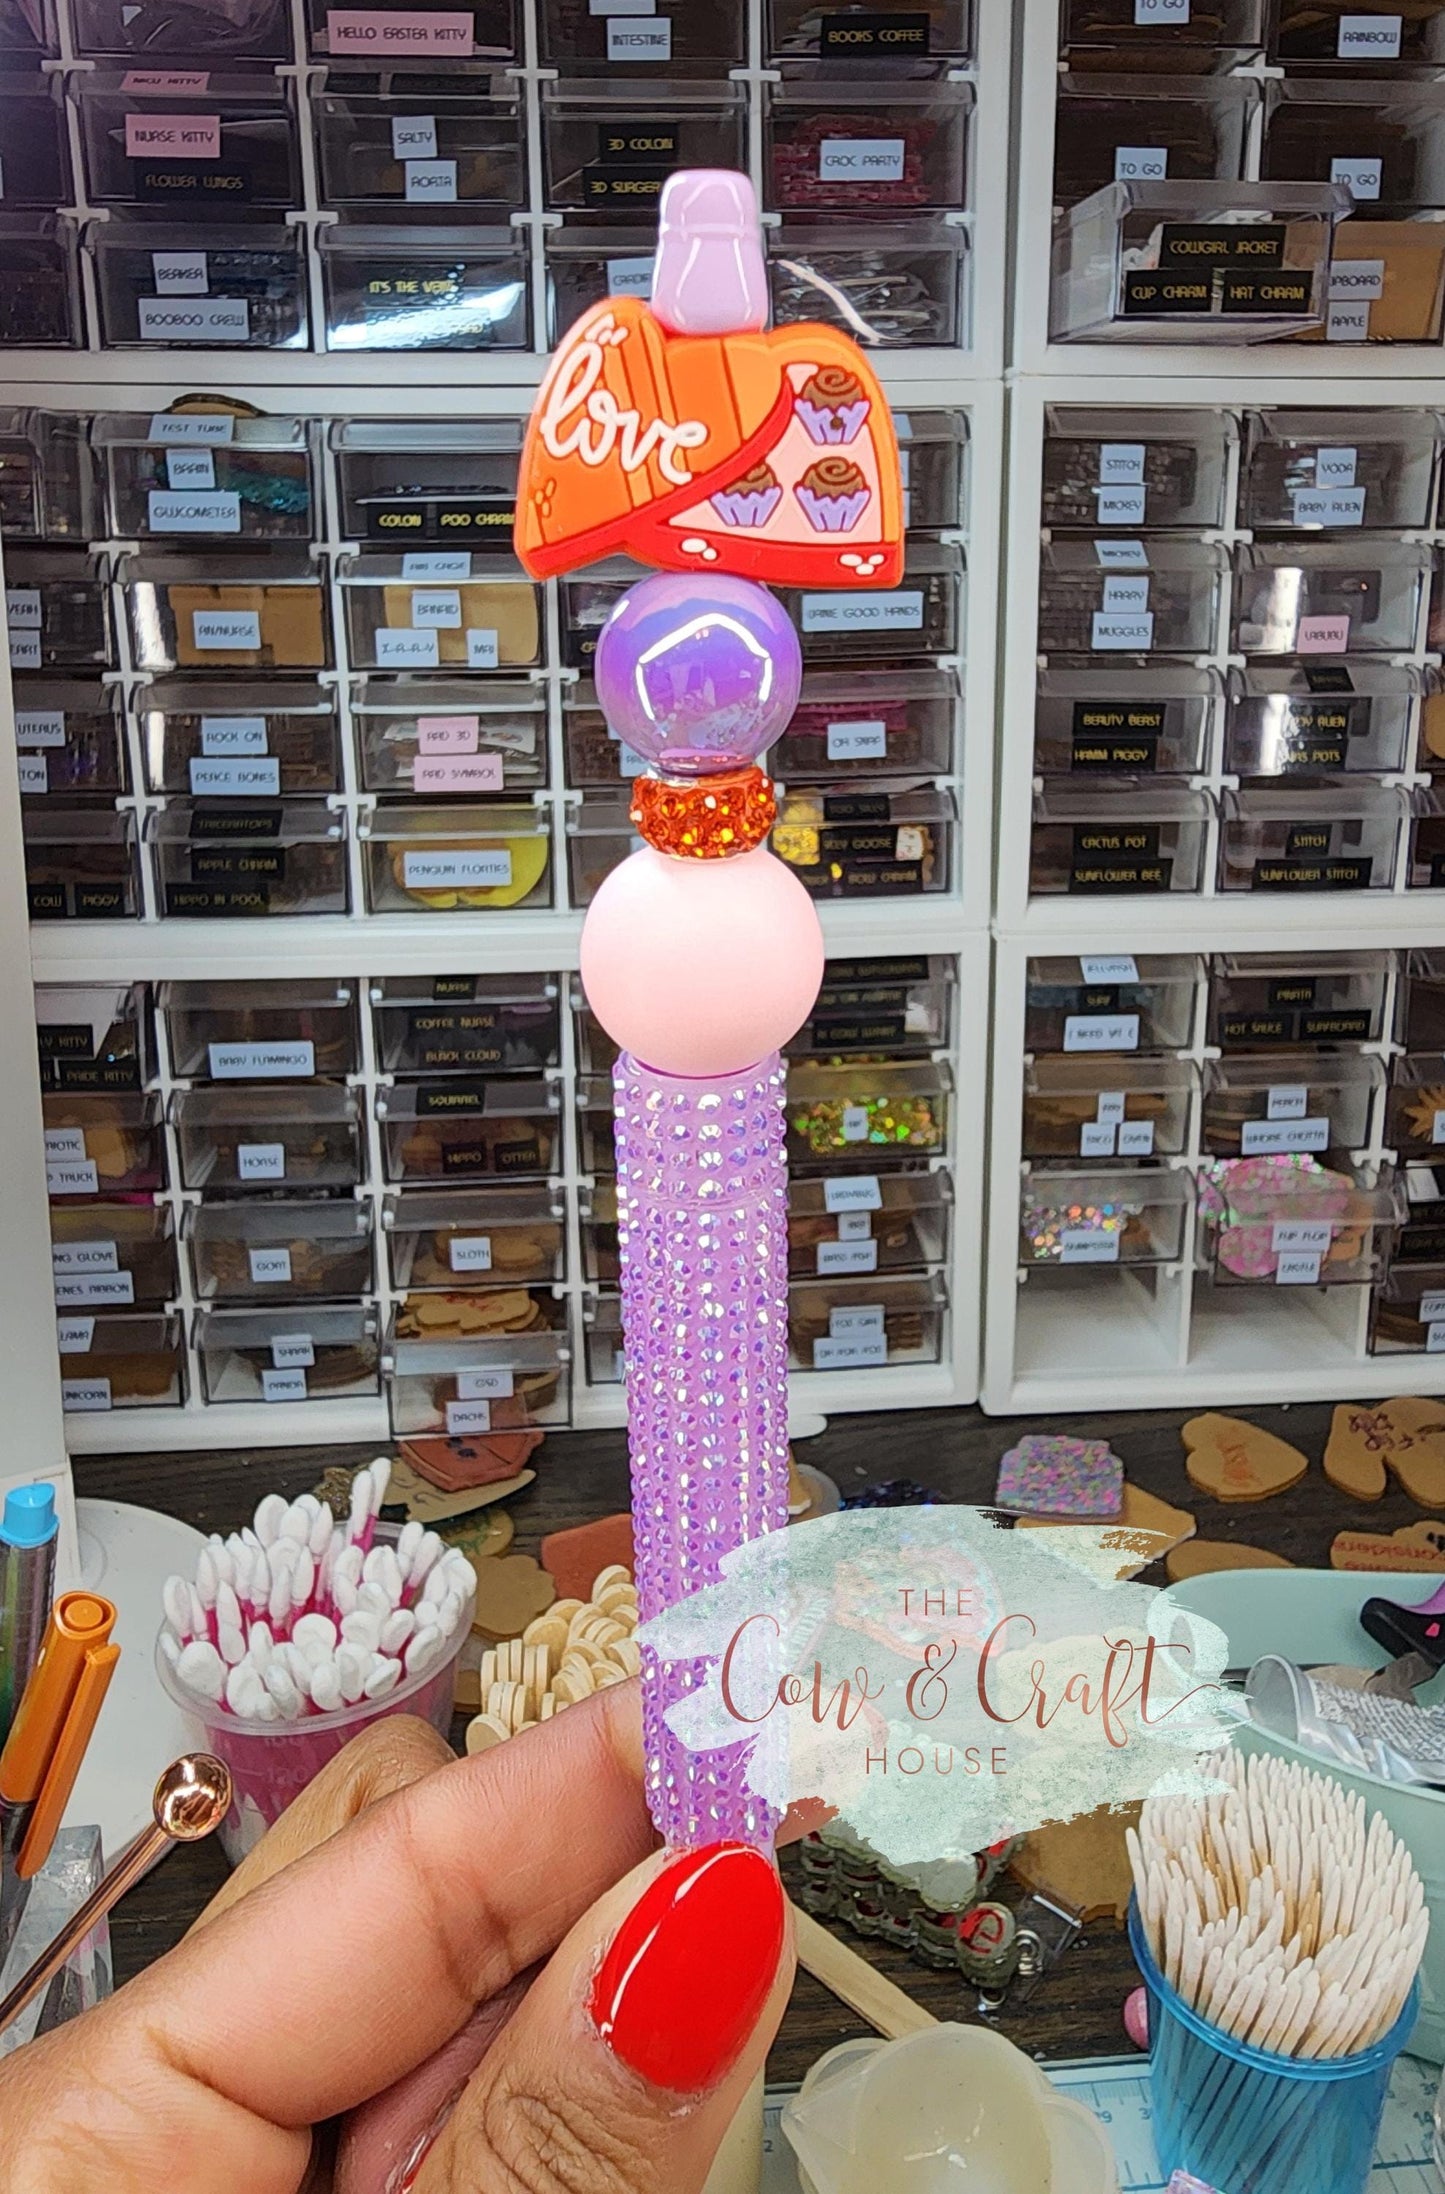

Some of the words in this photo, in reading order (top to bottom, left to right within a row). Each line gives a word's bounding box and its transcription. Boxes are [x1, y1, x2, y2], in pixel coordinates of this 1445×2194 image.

[337, 27, 377, 40] HELLO
[383, 27, 428, 40] EASTER
[434, 28, 468, 40] KITTY
[828, 30, 873, 43] BOOKS
[879, 29, 925, 42] COFFEE
[1343, 31, 1398, 44] RAINBOW
[135, 130, 176, 144] NURSE
[181, 130, 215, 144] KITTY
[397, 132, 433, 145] SALTY
[608, 138, 625, 151] 3D
[629, 138, 674, 151] COLON
[825, 155, 857, 167] CROC
[862, 154, 900, 167] PARTY
[1120, 163, 1137, 175] TO
[1143, 163, 1163, 175] GO
[145, 175, 198, 189] FLOWER
[203, 175, 244, 189] LUNGS
[1357, 173, 1377, 186] GO
[1170, 241, 1229, 255] COWGIRL
[1235, 240, 1279, 255] JACKET
[369, 280, 391, 294] IT'S
[394, 280, 419, 294] THE
[1131, 287, 1156, 300] CUP
[1163, 286, 1207, 299] CHARM
[1230, 287, 1253, 299] HAT
[1260, 287, 1304, 299] CHARM
[145, 313, 204, 327] BOOBOO
[209, 313, 245, 326] CREW
[1331, 315, 1365, 327] APPLE
[540, 342, 708, 486] love
[1106, 460, 1140, 471] STITCH
[1321, 463, 1353, 474] YODA
[1103, 501, 1142, 511] MICKEY
[1298, 502, 1326, 513] BABY
[1332, 501, 1362, 513] ALIEN
[378, 514, 422, 527] COLON
[440, 513, 471, 526] POO
[1108, 590, 1144, 601] HARRY
[843, 607, 879, 619] GOOD
[884, 606, 919, 617] HANDS
[1098, 626, 1149, 637] MUGGLES
[1083, 713, 1124, 727] BEAUTY
[1128, 713, 1162, 727] BEAST
[244, 731, 264, 742] ON
[833, 738, 850, 749] OH
[1113, 749, 1149, 761] PIGGY
[1081, 836, 1121, 849] CACTUS
[1124, 836, 1147, 849] POT
[1293, 834, 1326, 848] STITCH
[1074, 869, 1137, 882] SUNFLOWER
[1141, 869, 1163, 882] BEE
[1259, 868, 1321, 882] SUNFLOWER
[1326, 867, 1359, 880] STITCH
[33, 896, 62, 908] COW
[1225, 1024, 1246, 1035] HOT
[1251, 1023, 1283, 1034] SAUCE
[1306, 1019, 1365, 1033] SURFBOARD
[77, 1252, 113, 1263] GLOVE
[456, 1250, 490, 1260] SLOTH
[89, 1283, 129, 1294] RIBBON
